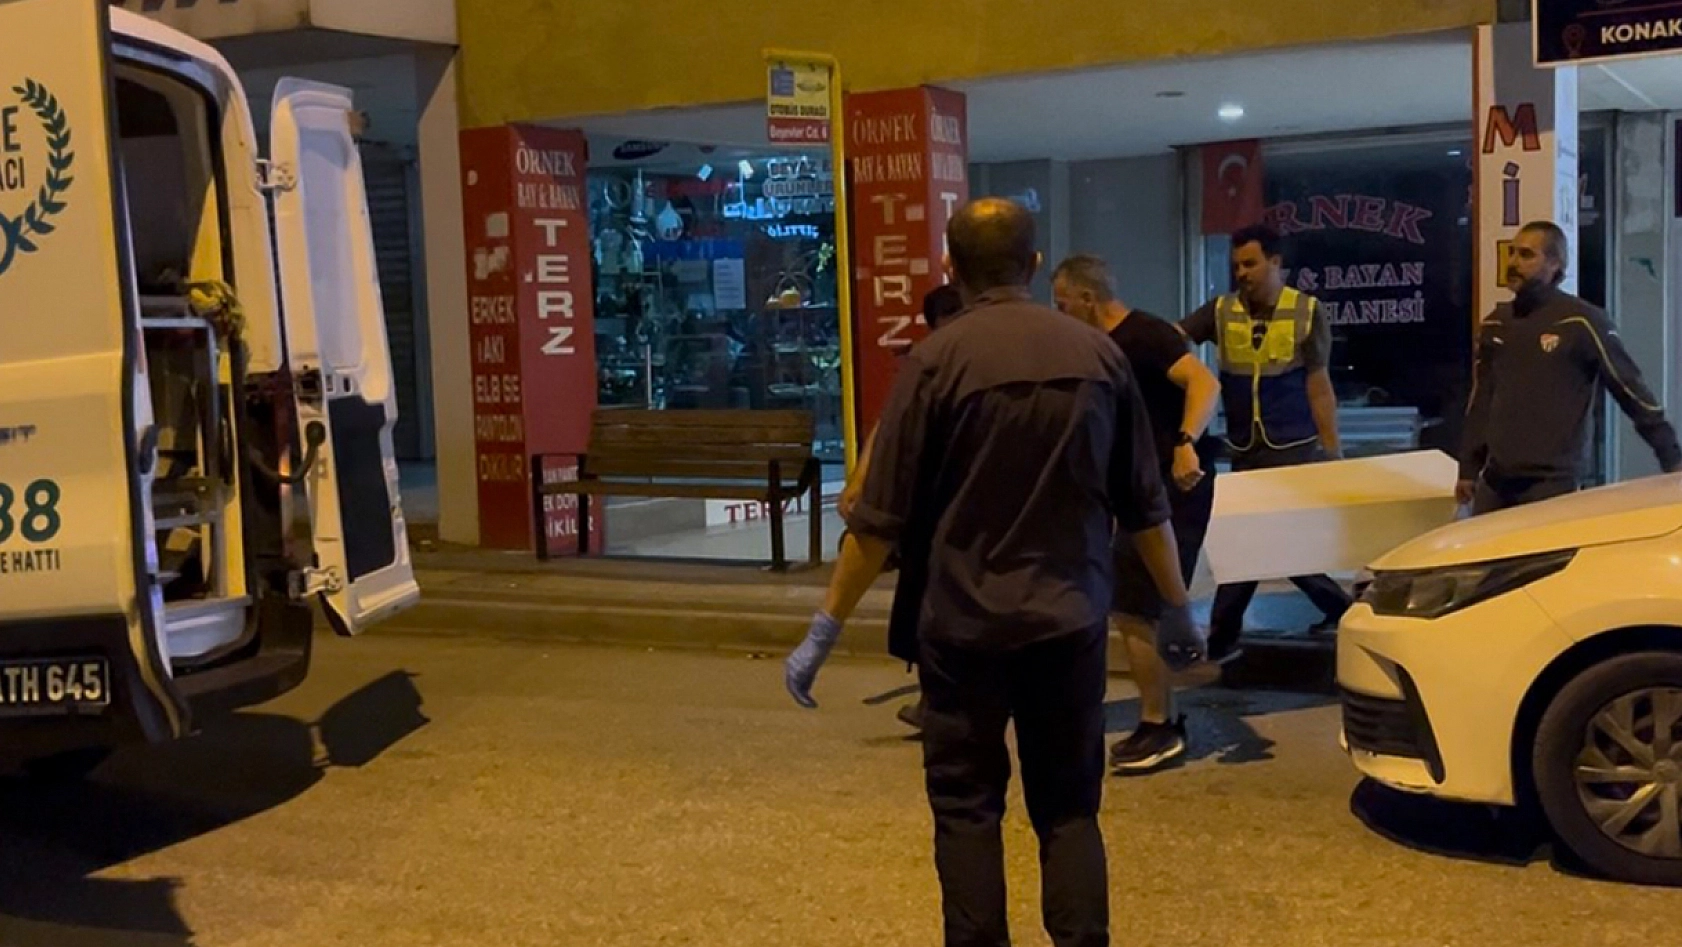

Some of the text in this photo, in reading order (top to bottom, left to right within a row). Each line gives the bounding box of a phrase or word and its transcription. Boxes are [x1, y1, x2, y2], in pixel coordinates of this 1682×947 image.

[852, 109, 918, 145] ÖRNEK
[0, 156, 25, 192] CI
[516, 141, 577, 178] ÖRNEK
[1266, 194, 1433, 244] RNEK
[1297, 267, 1319, 291] &
[1323, 261, 1425, 290] BAYAN
[473, 294, 516, 324] ERKEK
[0, 662, 102, 703] TH 645
